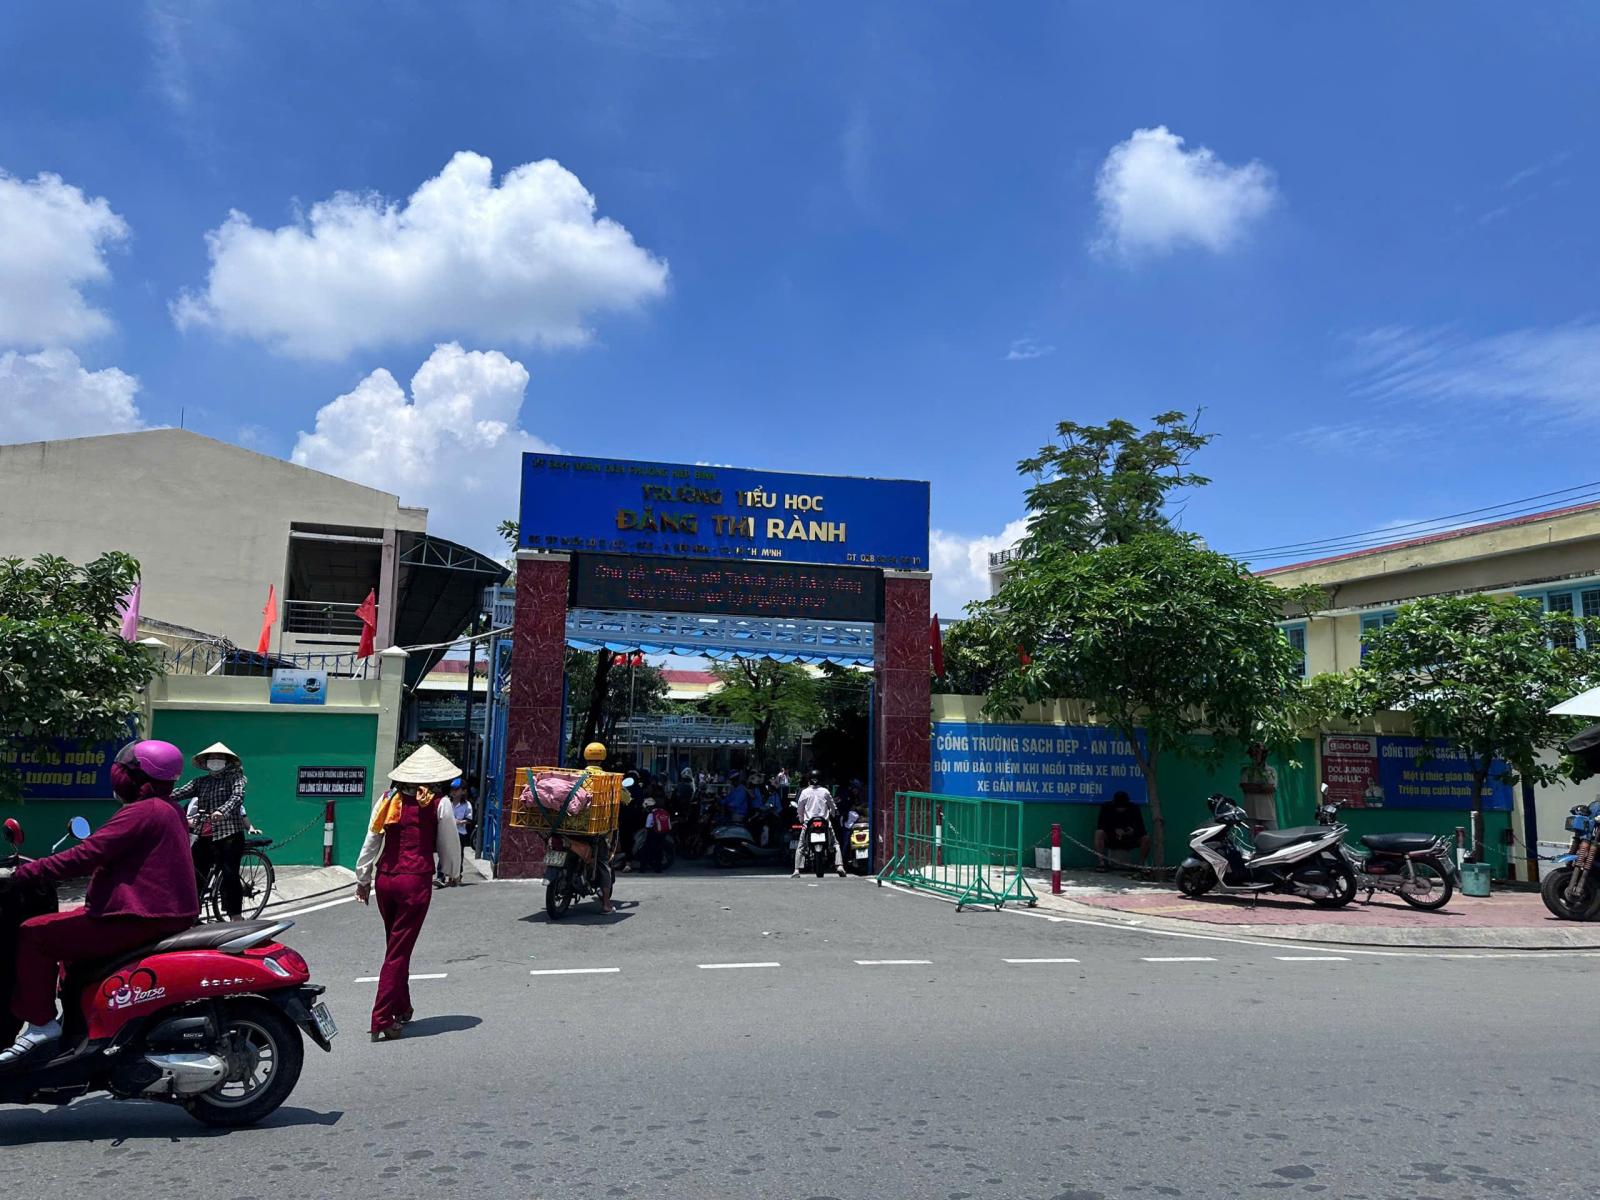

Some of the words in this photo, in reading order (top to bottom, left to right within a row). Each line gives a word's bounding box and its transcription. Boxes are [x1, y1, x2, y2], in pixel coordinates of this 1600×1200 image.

[735, 485, 776, 508] TIỂU
[784, 494, 824, 513] HỌC
[713, 514, 755, 540] THỊ
[767, 515, 846, 543] RÀNH
[936, 731, 969, 751] CỔNG
[972, 733, 1019, 752] TRƯỜNG
[1022, 738, 1053, 756] SẠCH
[1056, 738, 1080, 757] ĐẸP
[1091, 740, 1108, 755] AN
[64, 750, 106, 767] nghệ
[934, 759, 951, 775] ĐỘI
[953, 759, 970, 773] MŨ
[972, 758, 992, 773] BẢO
[995, 758, 1020, 774] HIỂM
[1023, 762, 1040, 775] KHI
[1068, 762, 1093, 776] TRÊN
[1095, 764, 1108, 777] XE
[1111, 763, 1127, 777] MÔ
[75, 771, 97, 785] lai
[977, 780, 990, 792] XE
[1016, 779, 1040, 794] MÁY,
[1042, 781, 1055, 793] XE
[1057, 781, 1077, 796] ĐẠP
[1080, 780, 1103, 797] ĐIỆN
